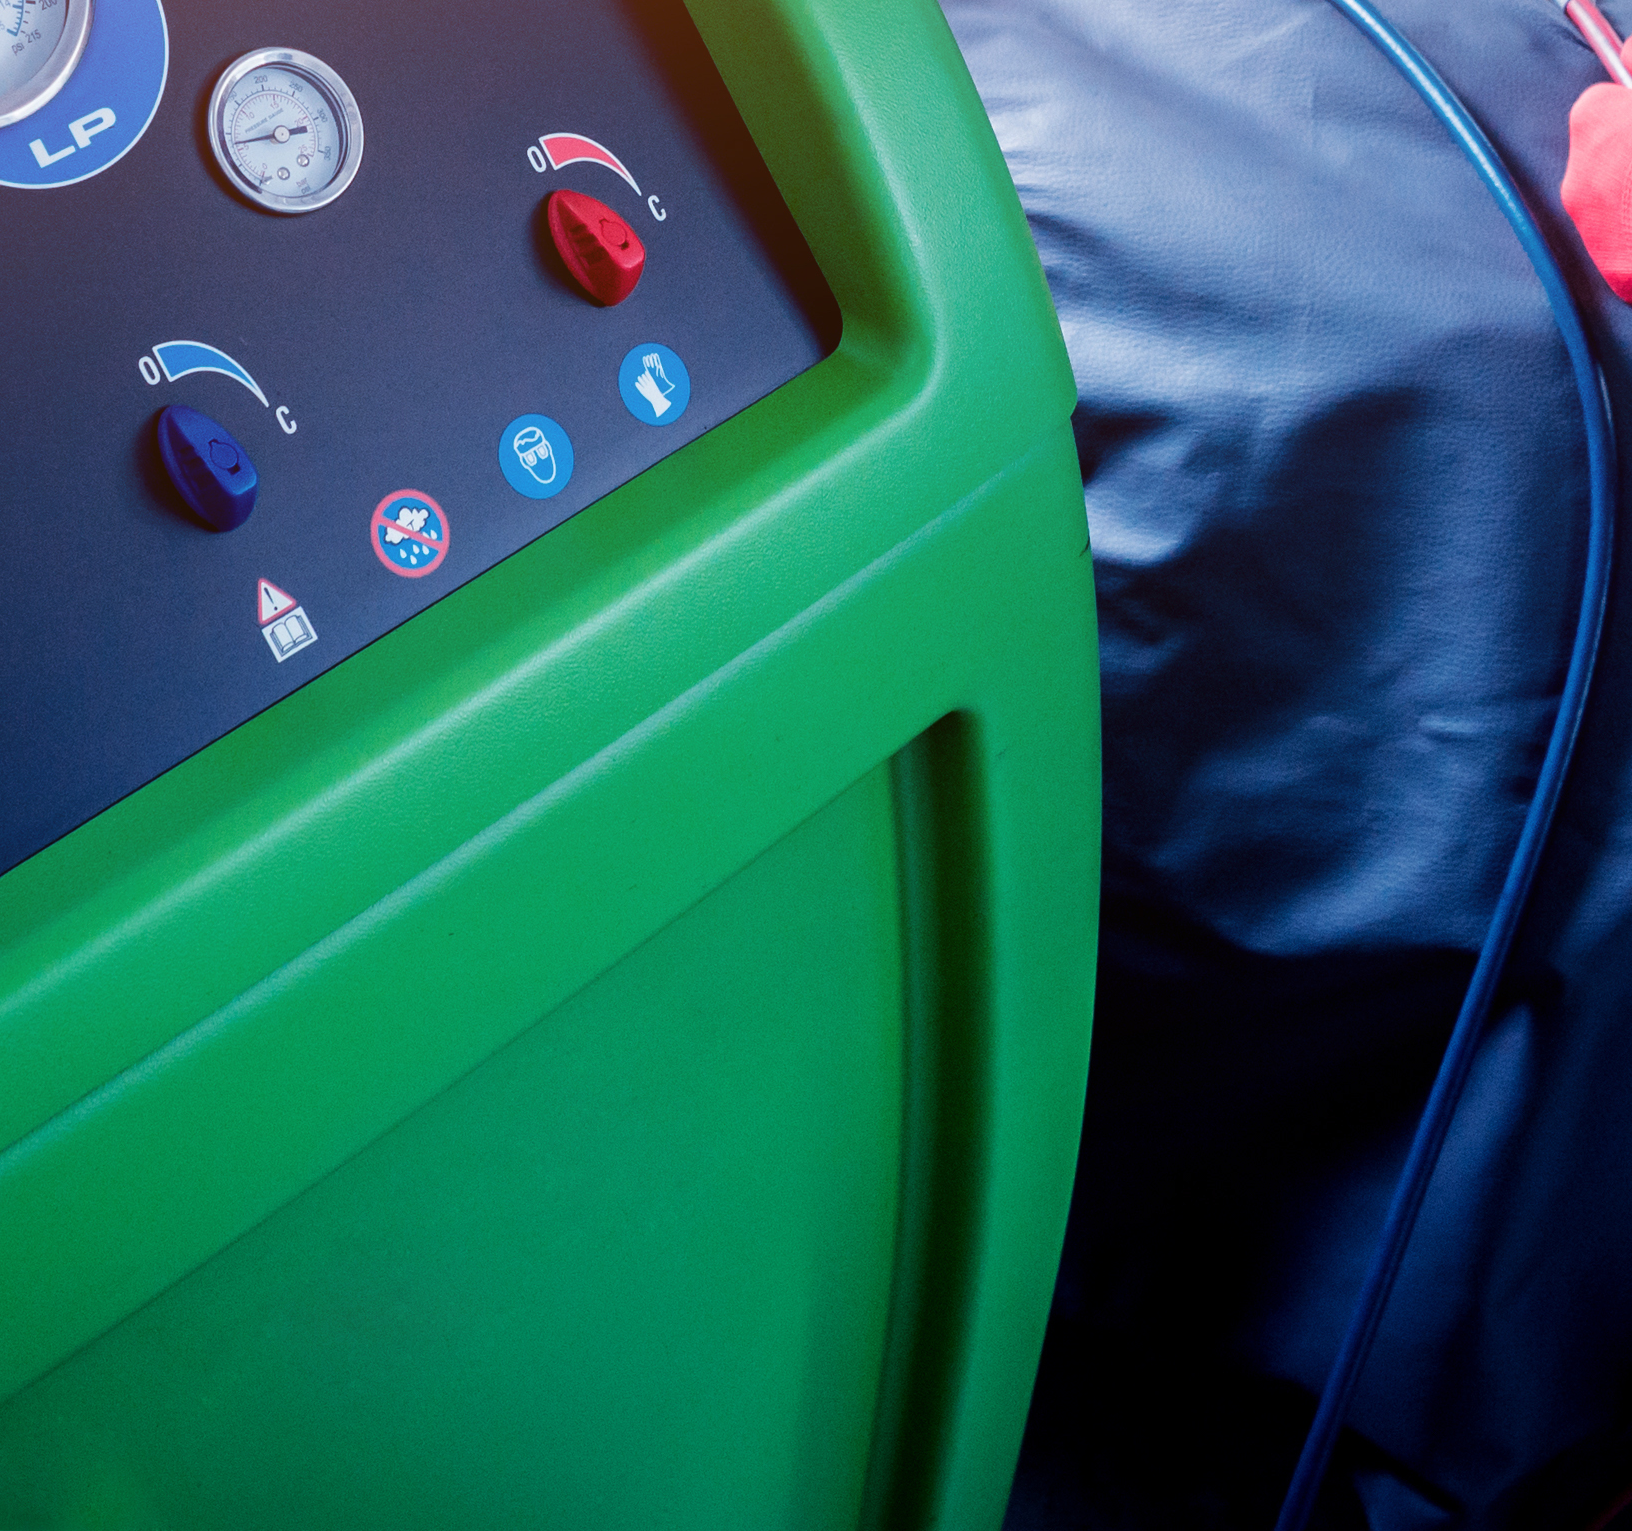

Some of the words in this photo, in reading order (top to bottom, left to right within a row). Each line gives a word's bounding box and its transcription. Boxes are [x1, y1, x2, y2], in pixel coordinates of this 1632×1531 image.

[26, 29, 42, 44] 215
[11, 40, 25, 56] psi
[253, 74, 268, 84] 200
[317, 108, 328, 123] 300
[28, 106, 117, 169] LP
[646, 194, 668, 222] C
[275, 404, 297, 435] C
